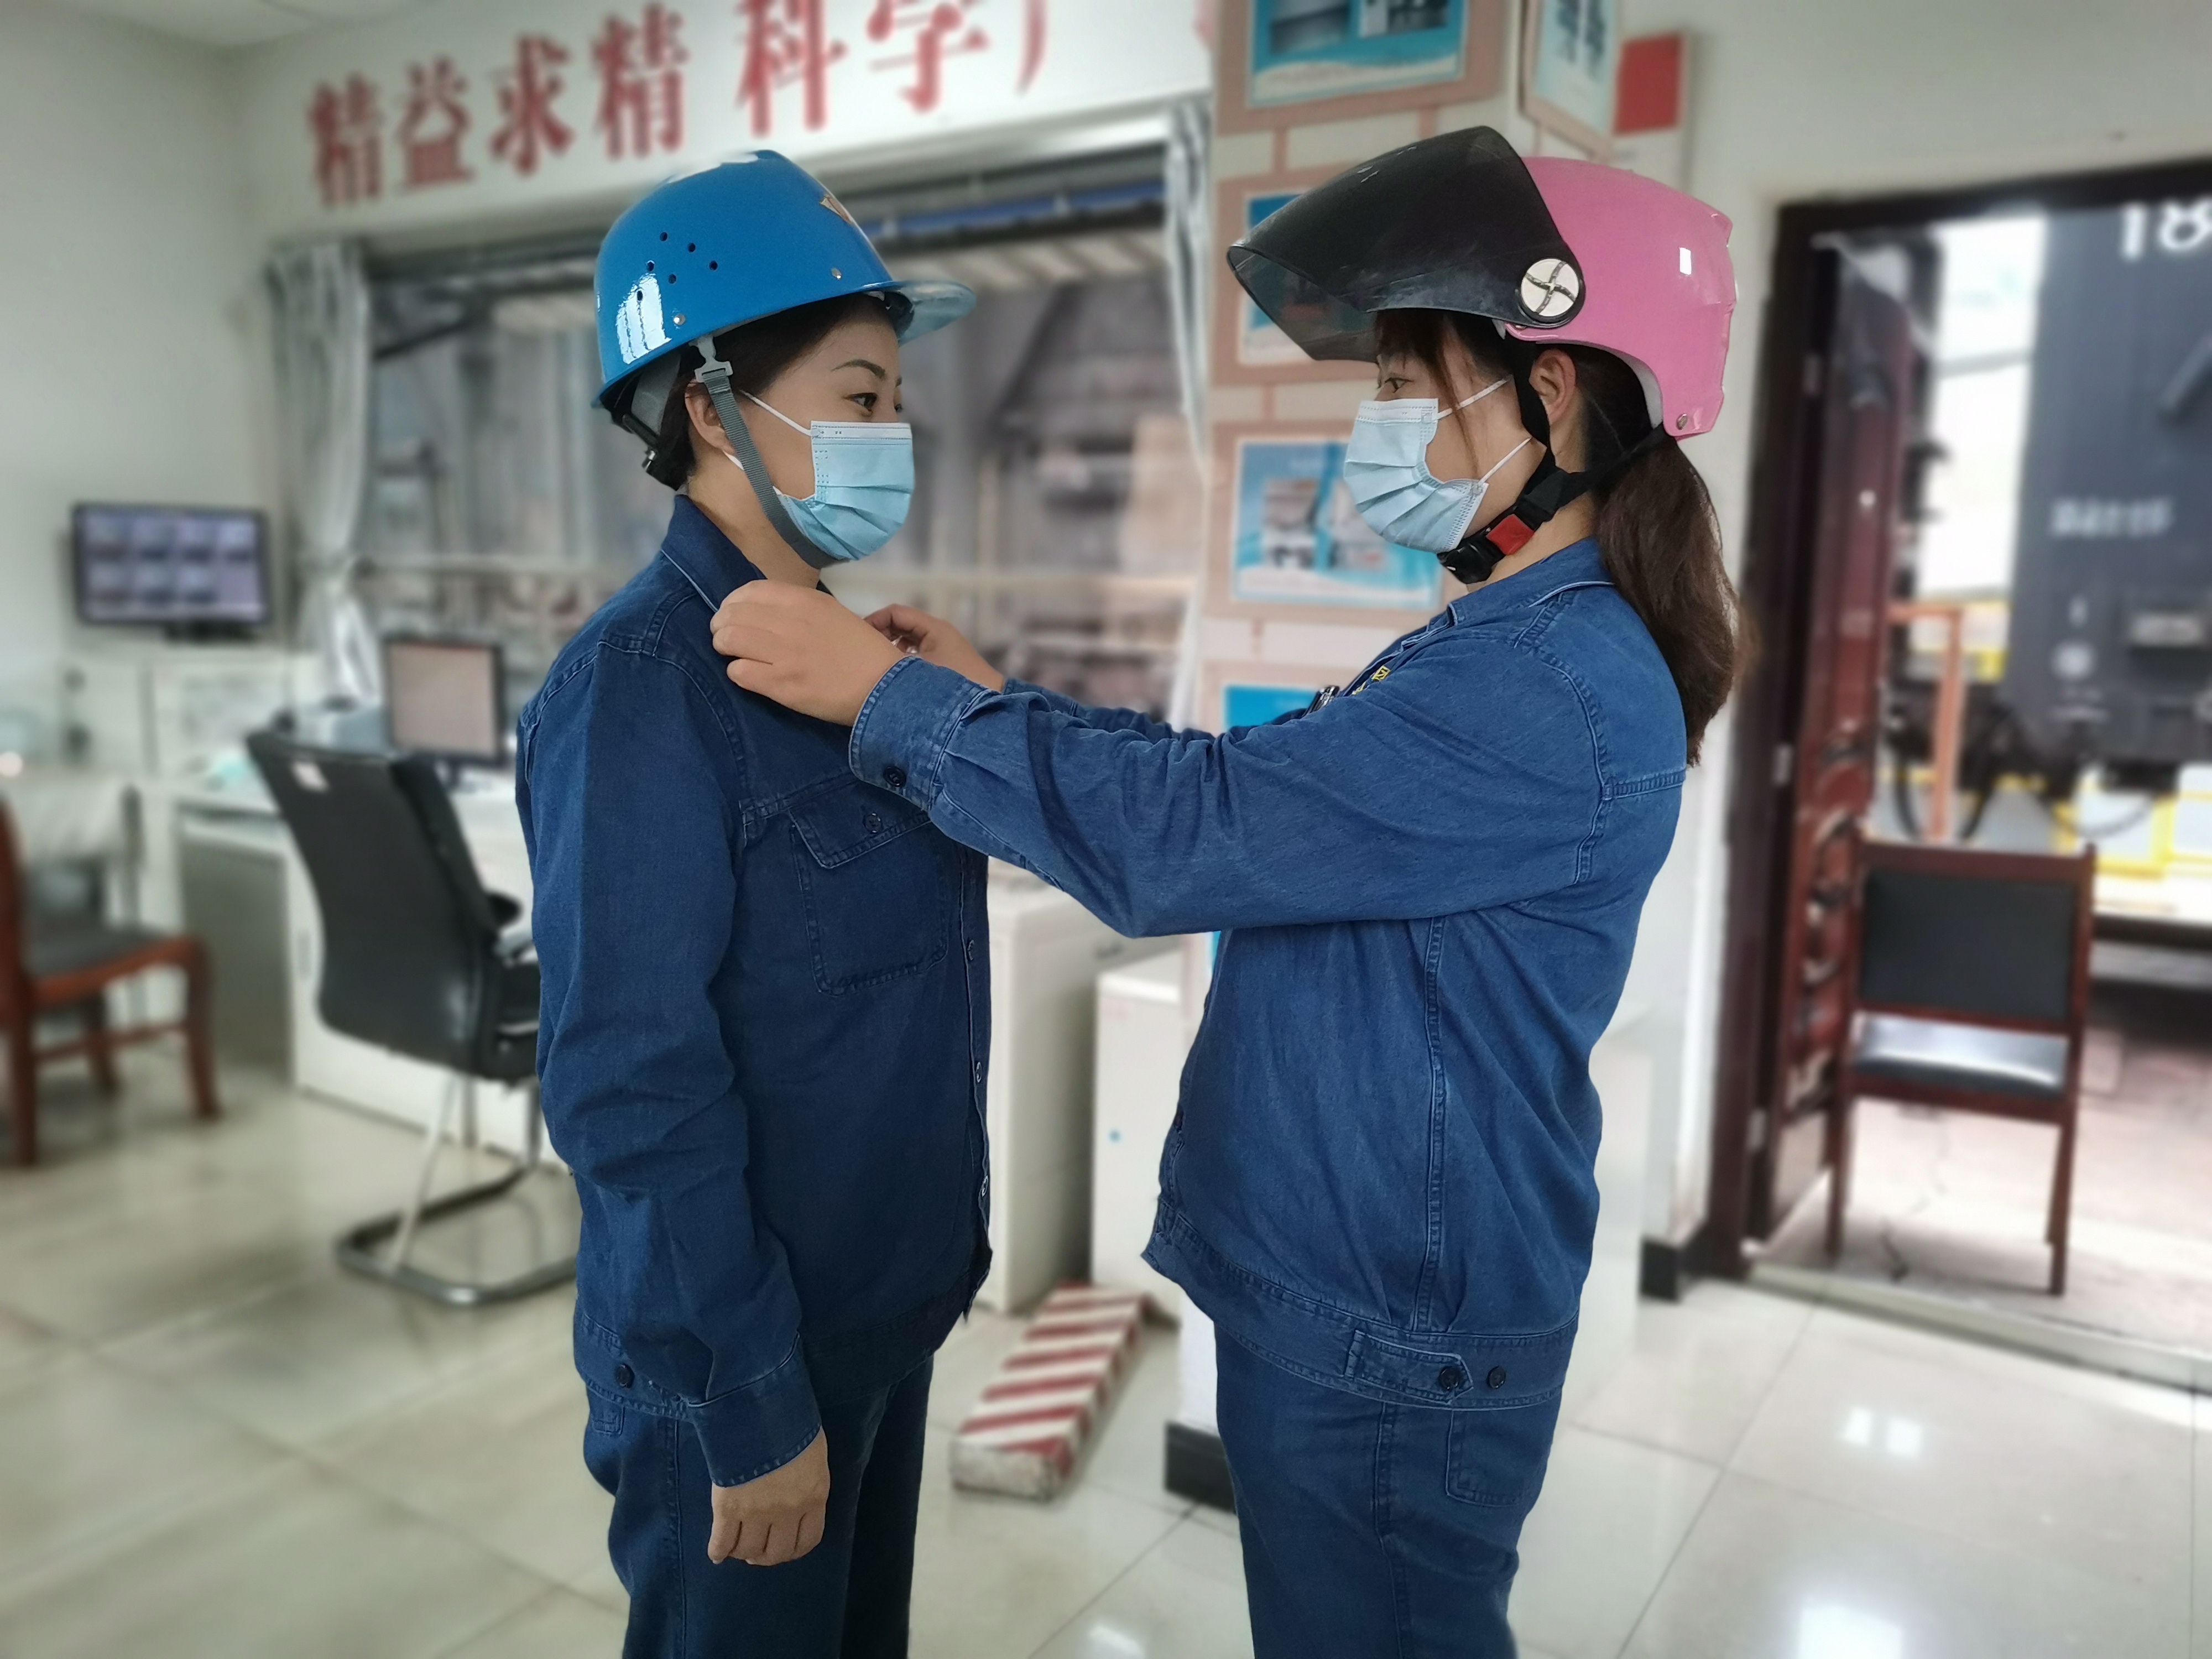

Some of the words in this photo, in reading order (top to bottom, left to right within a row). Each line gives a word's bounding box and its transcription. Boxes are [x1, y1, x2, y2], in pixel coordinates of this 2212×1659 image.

[307, 2, 690, 207] 精益求精
[737, 0, 1047, 135] 科学
